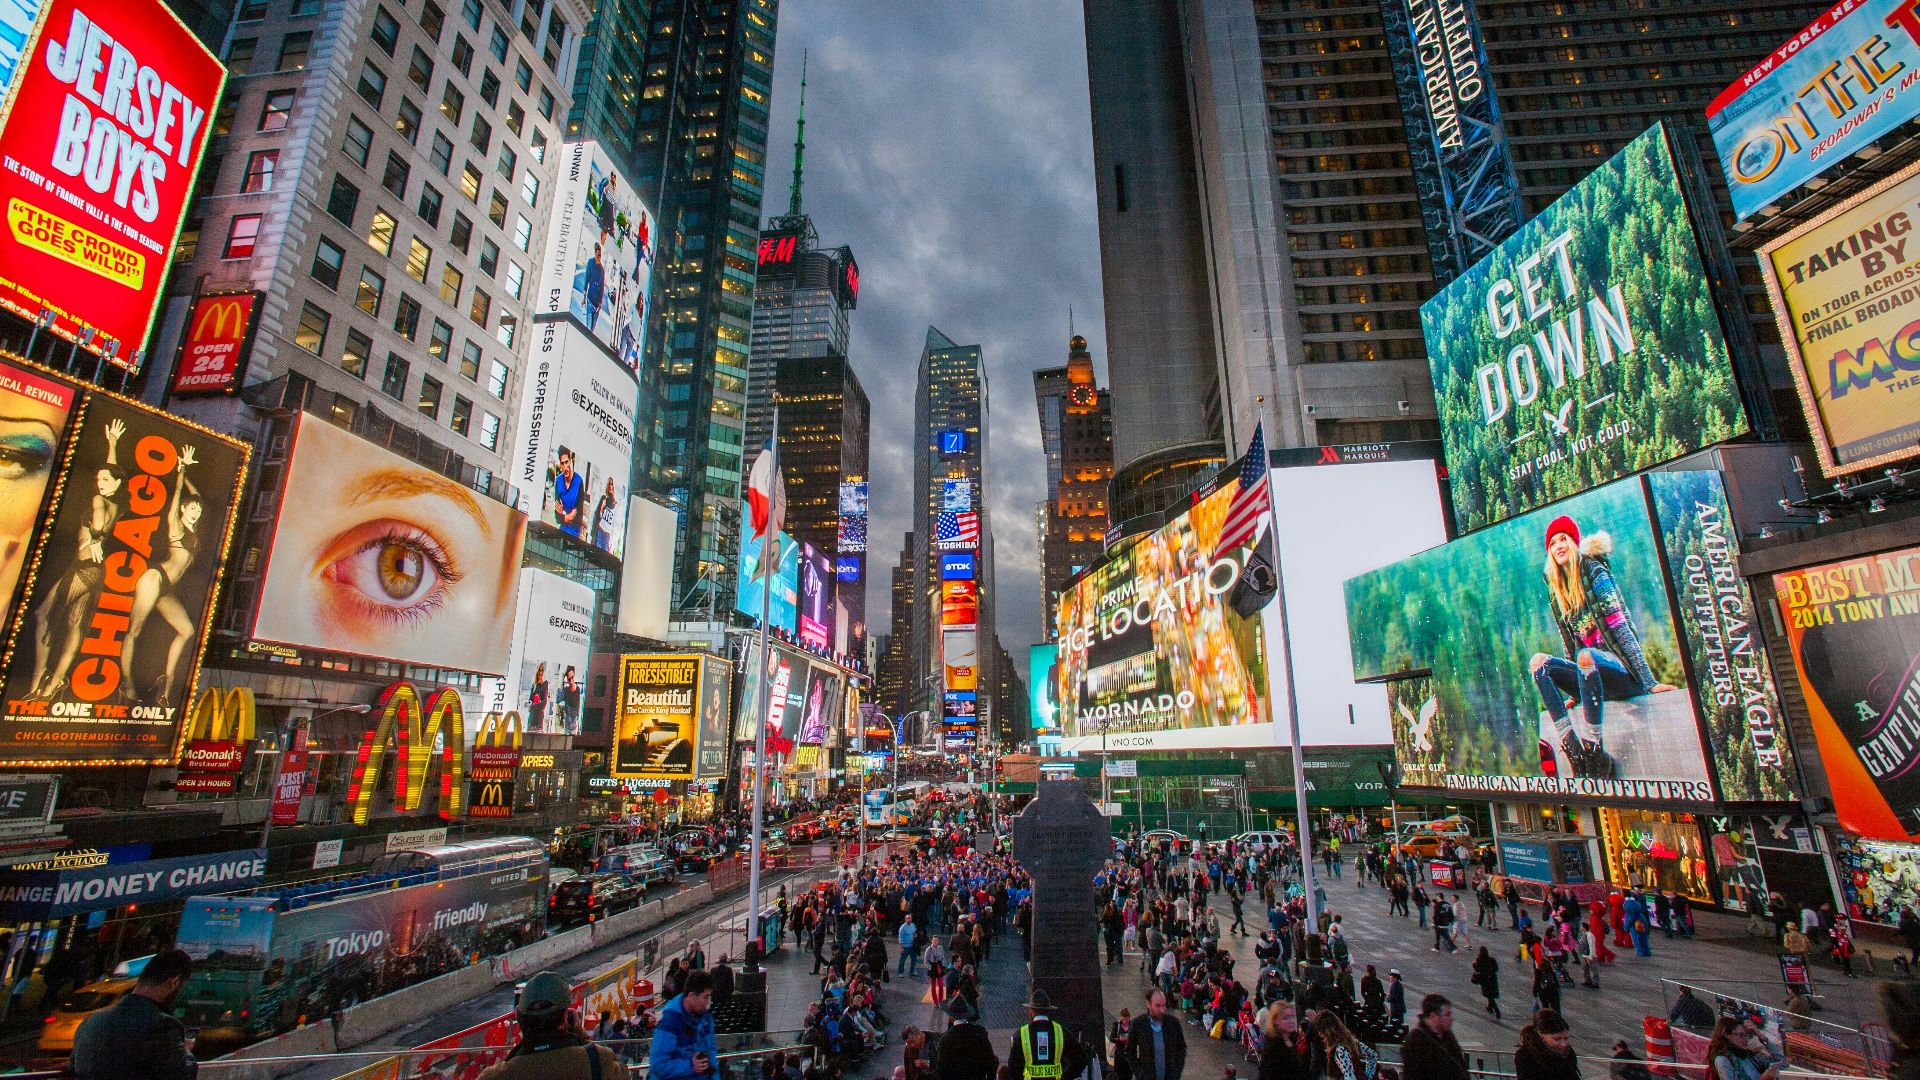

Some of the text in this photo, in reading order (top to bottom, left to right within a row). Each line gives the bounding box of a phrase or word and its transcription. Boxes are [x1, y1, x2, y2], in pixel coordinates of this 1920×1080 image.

[1743, 0, 1861, 87] NEW YORK, NE
[46, 8, 205, 168] JERSEY
[1412, 7, 1463, 149] AMERICAN
[1731, 102, 1820, 184] ON
[1797, 34, 1906, 119] THE
[1809, 86, 1896, 161] BROADWAY'S
[51, 93, 167, 222] BOYS
[4, 155, 165, 255] THE STORY OF FRANKIE VALLI & THE FOUR SEASONS
[18, 220, 76, 253] GOES
[71, 229, 138, 267] CROWD
[1787, 211, 1912, 284] TAKING
[1860, 236, 1908, 279] BY
[17, 284, 42, 304] Wilson
[1487, 230, 1576, 339] GET
[1802, 261, 1920, 324] ON TOUR ACROSS
[1807, 316, 1853, 344] FINAL
[192, 343, 235, 355] OPEN
[1477, 284, 1635, 426] DOWN
[193, 356, 227, 372] 24
[180, 372, 231, 386] HOURS
[25, 384, 63, 407] REVIVAL
[523, 361, 550, 483] @EXPRESSRUNWAY
[1343, 444, 1392, 453] MARRIOTT
[1343, 452, 1388, 461] MARQUIS
[1509, 419, 1637, 480] STAY COOL. NOT COLD.
[938, 541, 977, 550] TOSHIBA
[70, 434, 179, 701] CHICAGO
[1101, 557, 1239, 641] LOCATIO
[1102, 575, 1145, 611] PRIME
[1782, 562, 1871, 608] BEST
[1792, 604, 1835, 629] 2014
[1835, 598, 1884, 623] TONY
[1685, 554, 1738, 707] OUTFITTERS
[1694, 500, 1784, 768] AMERICAN EAGLE
[7, 700, 176, 720] THE ONE THE ONLY
[627, 688, 692, 706] Beautiful
[627, 706, 638, 714] The
[656, 706, 670, 715] King
[670, 706, 691, 714] Musical
[1083, 691, 1195, 723] VORNADO
[1854, 700, 1880, 722] A
[1136, 715, 1173, 725] TRUST
[15, 731, 157, 741] CHICAGOTHEMUSICAL.COM
[183, 749, 242, 760] McDonald's
[189, 760, 232, 768] Restaurant
[473, 752, 519, 760] McDonald's
[521, 755, 554, 768] XPRESS
[1403, 763, 1425, 772] GREAT
[177, 779, 196, 787] OPEN
[278, 771, 306, 787] JERSEY
[280, 784, 301, 799] BOYS
[590, 778, 671, 787] GIFTS LUGGAGE
[1447, 774, 1713, 801] AMERICAN EAGLE OUTFITTERS
[53, 854, 110, 868] EXCHANGE
[55, 871, 166, 905] MONEY
[168, 857, 268, 888] CHANGE
[491, 872, 520, 885] UNITED
[326, 928, 384, 961] Tokyo
